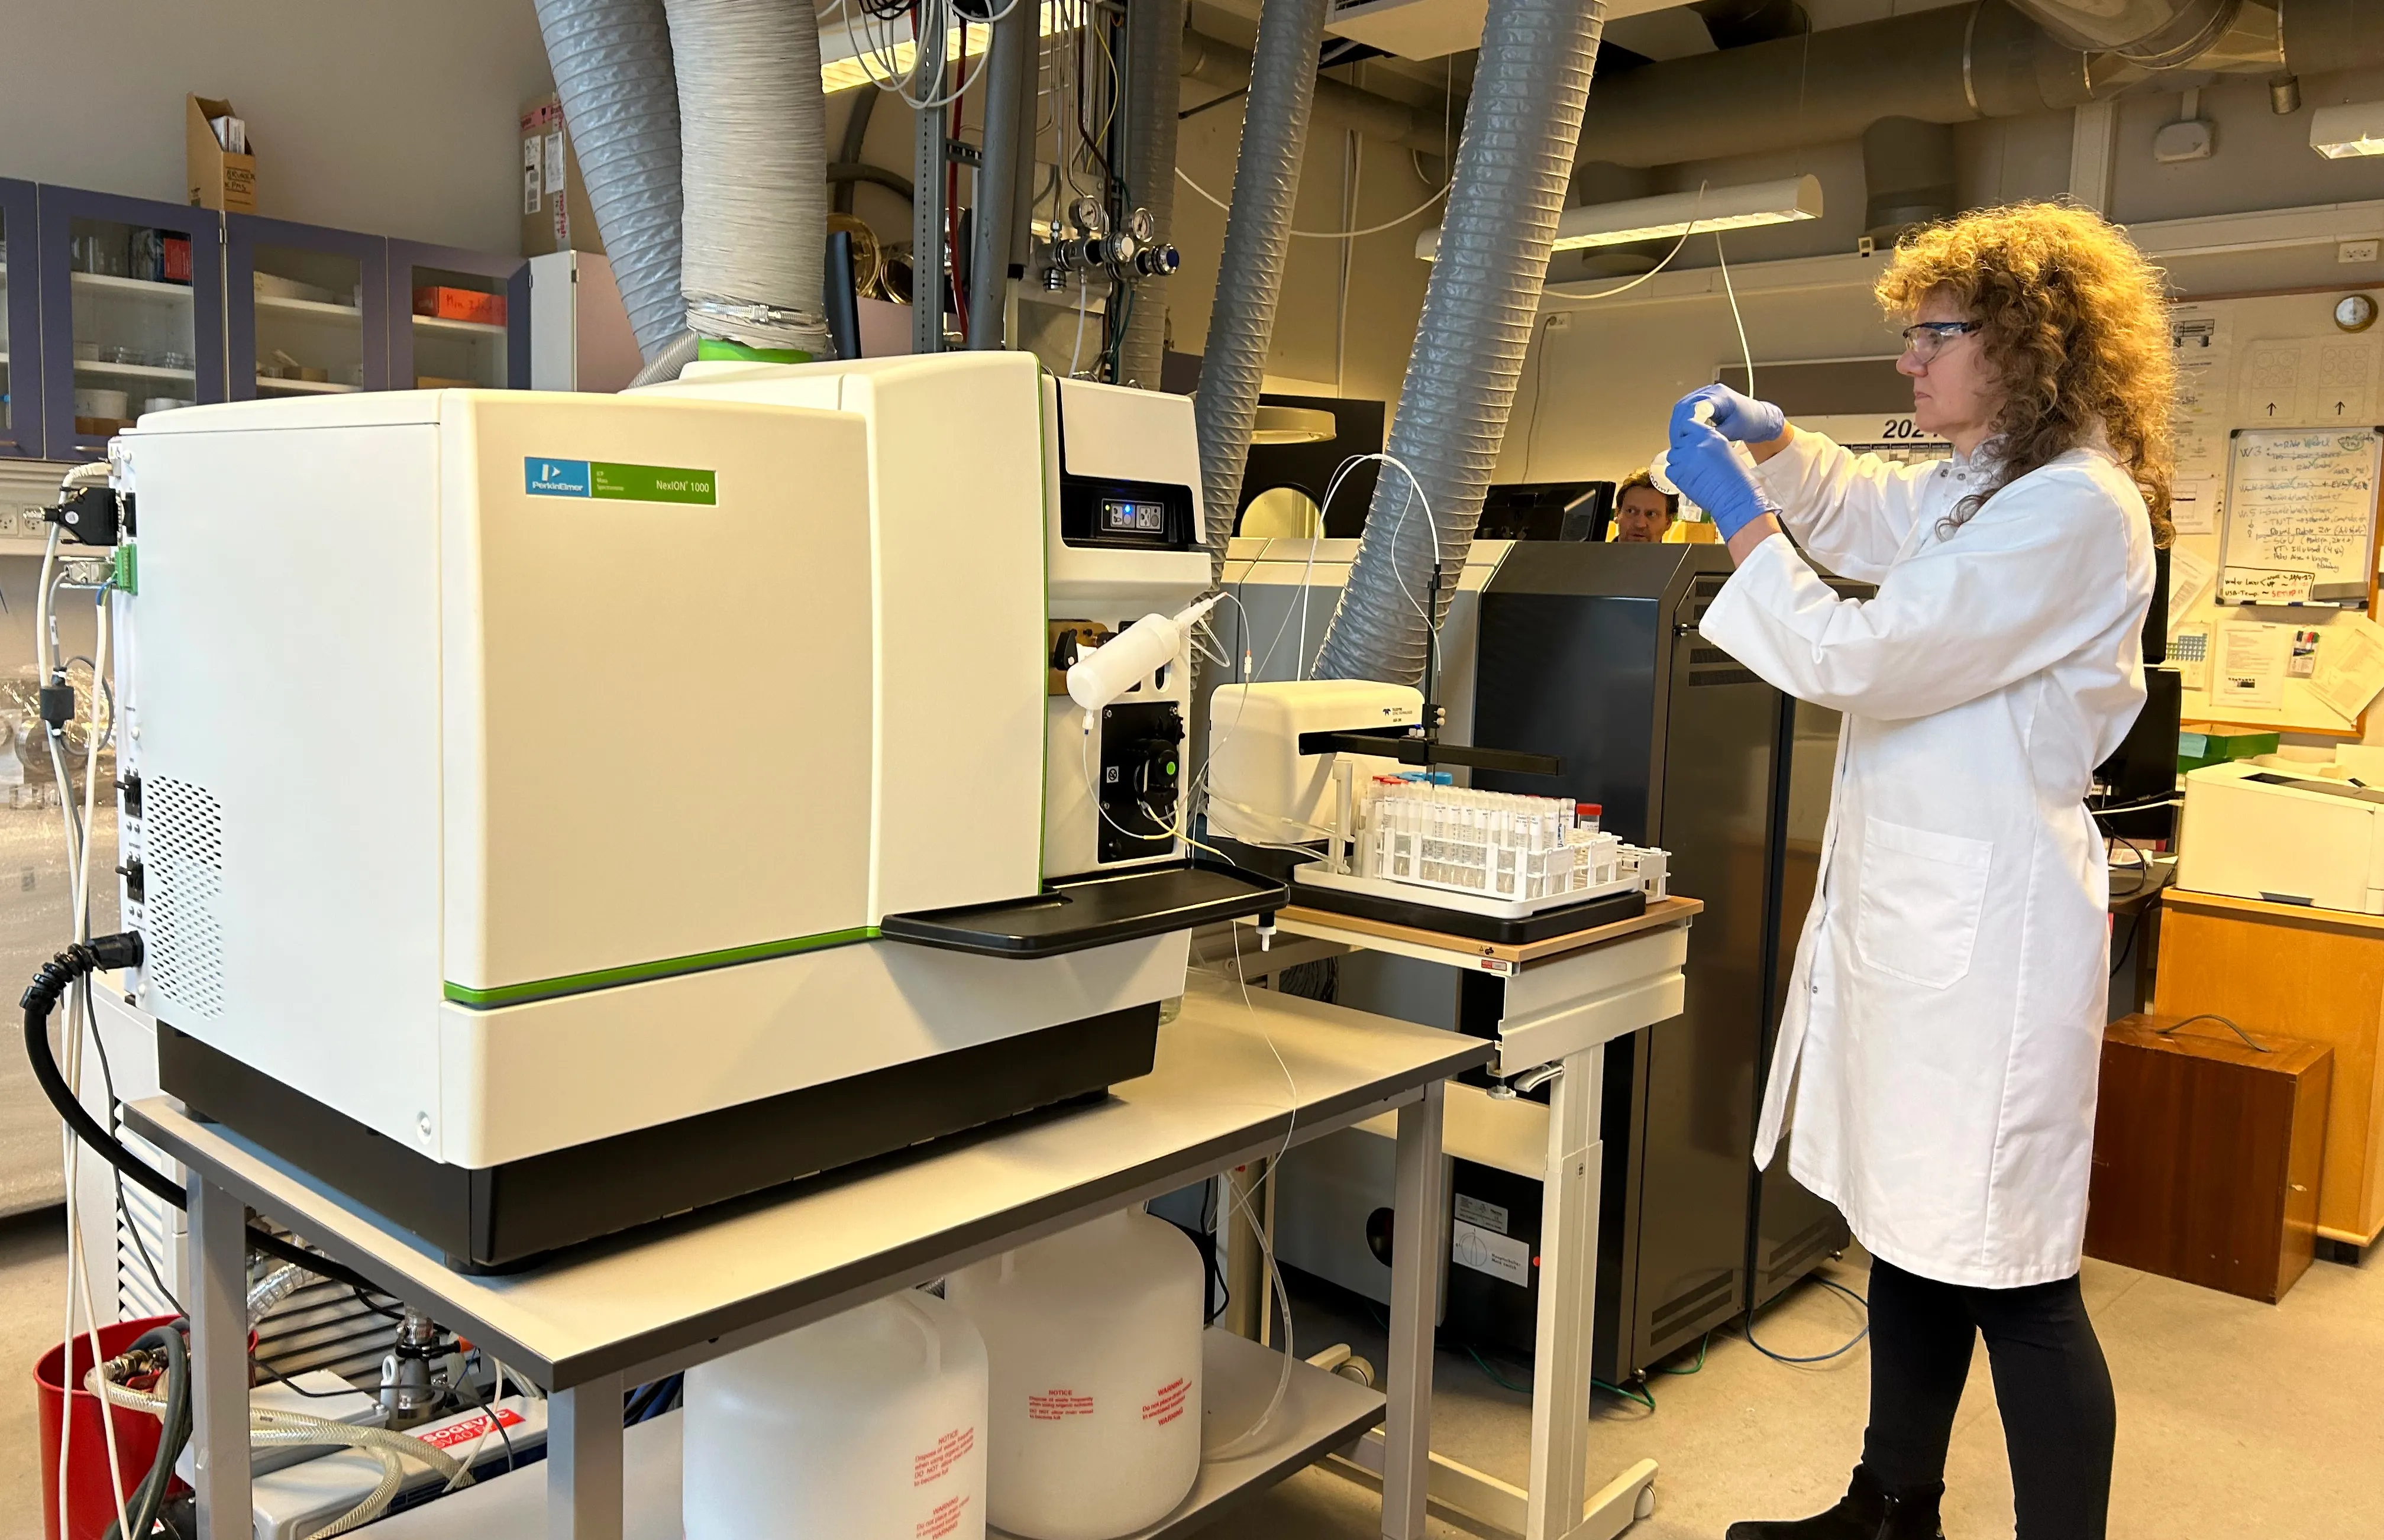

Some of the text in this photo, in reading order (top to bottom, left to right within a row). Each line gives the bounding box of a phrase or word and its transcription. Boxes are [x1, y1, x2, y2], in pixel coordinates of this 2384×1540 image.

[1882, 419, 1937, 438] 202
[532, 481, 583, 492] PerkinElmer
[690, 482, 709, 493] 1000
[1158, 1377, 1183, 1396] WARNING
[1158, 1406, 1183, 1426] WARNING
[423, 1411, 509, 1442] SOGEVC
[938, 1428, 959, 1445] NOTICE
[915, 1470, 924, 1479] DO
[926, 1464, 938, 1474] NOT
[932, 1494, 959, 1515] WARNING
[932, 1520, 958, 1540] WARNING
